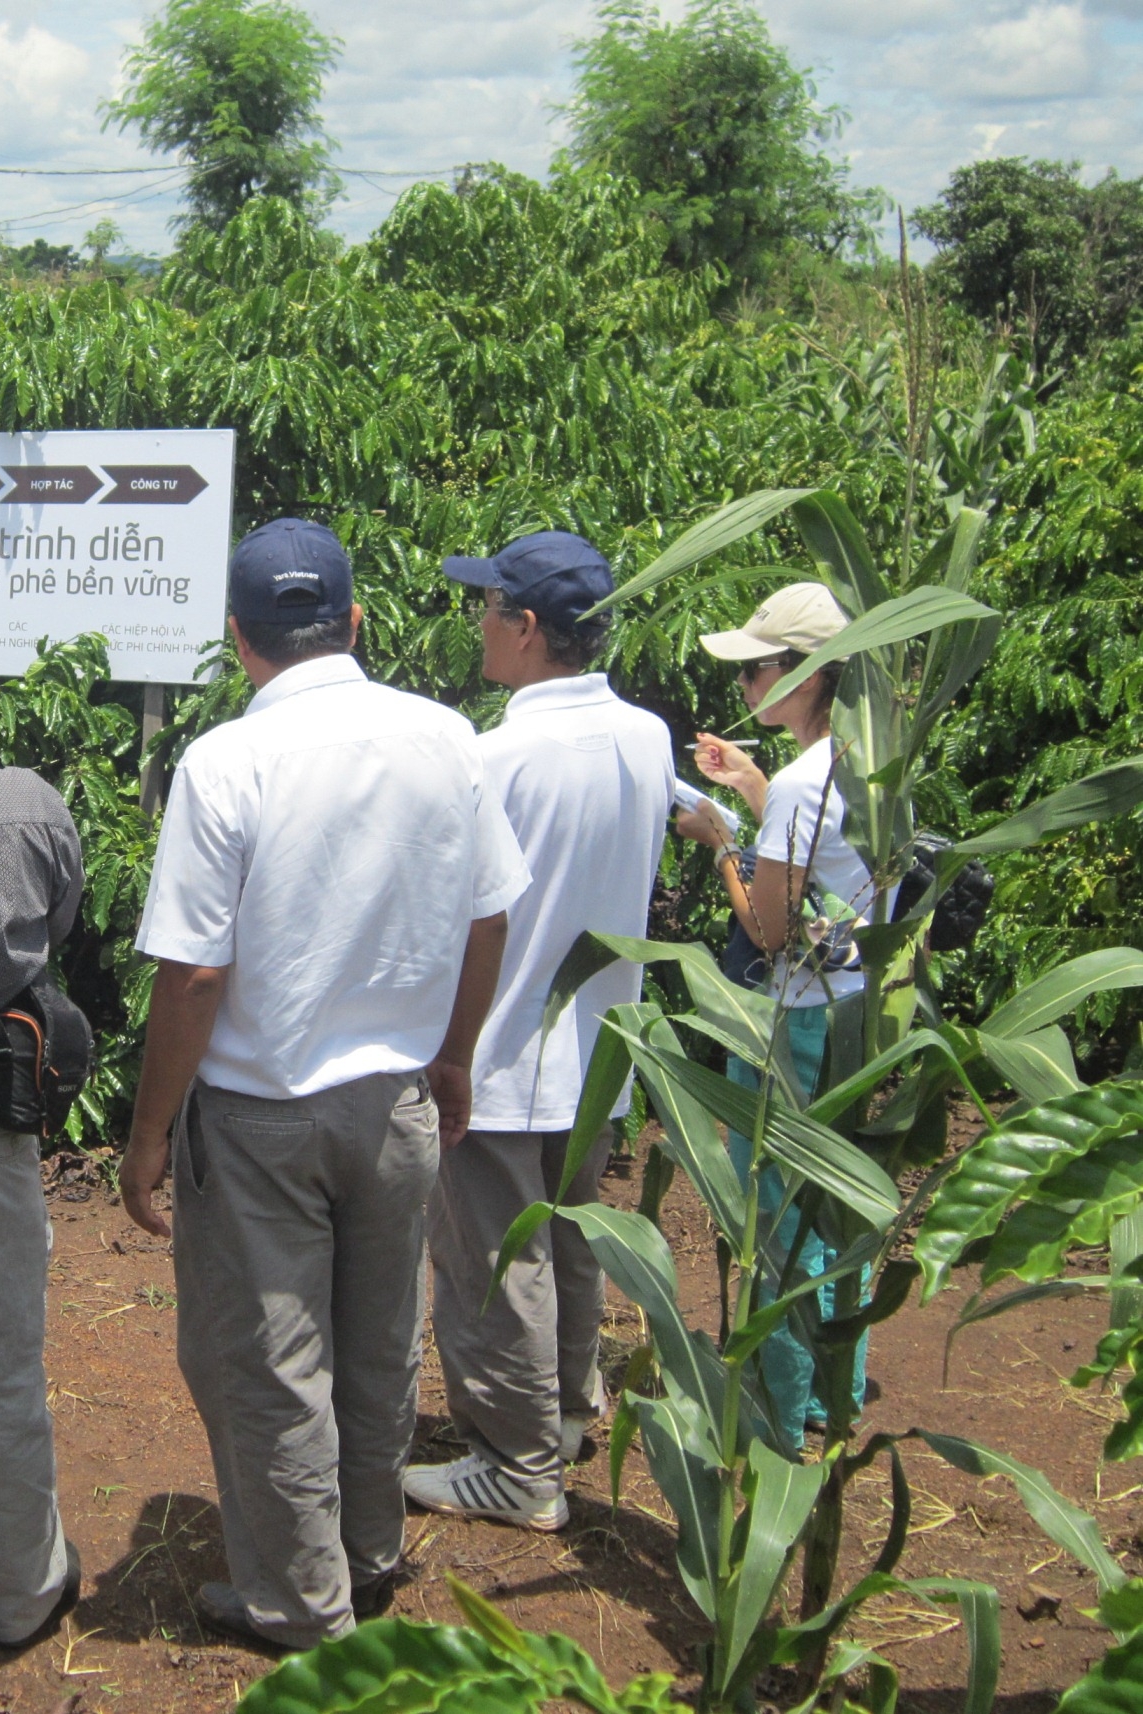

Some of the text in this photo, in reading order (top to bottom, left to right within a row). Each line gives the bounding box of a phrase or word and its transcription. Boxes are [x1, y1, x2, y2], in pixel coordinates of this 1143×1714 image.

[30, 480, 52, 491] HỢP
[55, 478, 74, 490] TÁC
[130, 478, 160, 490] CÔNG
[162, 480, 178, 490] TƯ
[0, 525, 76, 560] trình
[89, 522, 164, 561] diễn
[9, 567, 56, 599] phê
[66, 565, 113, 595] bền
[124, 569, 191, 604] vững
[8, 620, 28, 631] CÁC
[101, 622, 186, 637] CÁC HIỆP HỘI VÀ
[8, 636, 39, 648] NGHI
[126, 641, 144, 652] PHI
[146, 640, 180, 653] CHÍNH
[183, 641, 203, 653] PH
